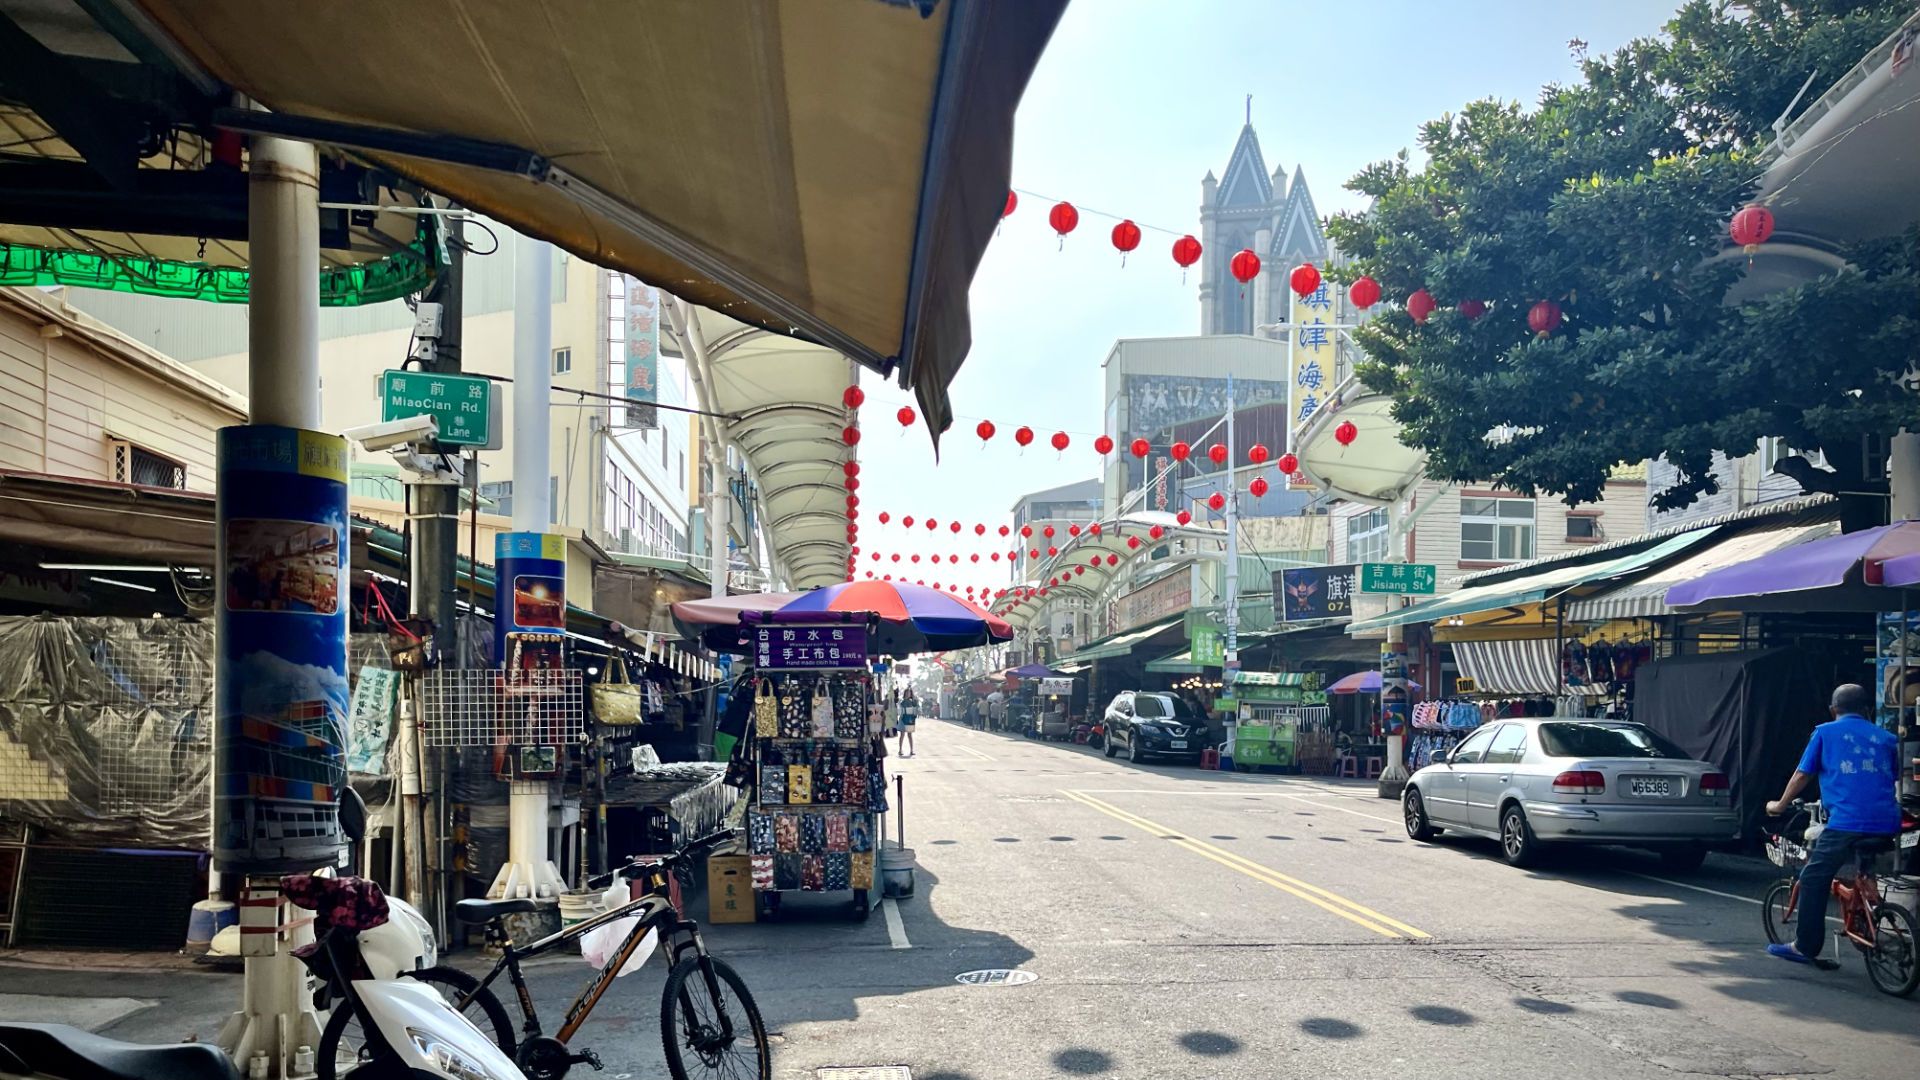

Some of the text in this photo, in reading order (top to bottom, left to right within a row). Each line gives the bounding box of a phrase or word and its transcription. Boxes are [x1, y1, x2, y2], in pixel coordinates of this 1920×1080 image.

[391, 378, 482, 399] 廟前路
[392, 396, 481, 413] MiaoCian Rd.
[447, 425, 471, 438] Lane
[1372, 565, 1427, 580] 吉祥街
[1371, 580, 1407, 592] Jisiang
[783, 630, 844, 641] 防水包
[758, 629, 770, 667] 台灣製
[782, 648, 840, 660] 手工布包
[1459, 680, 1474, 691] 100
